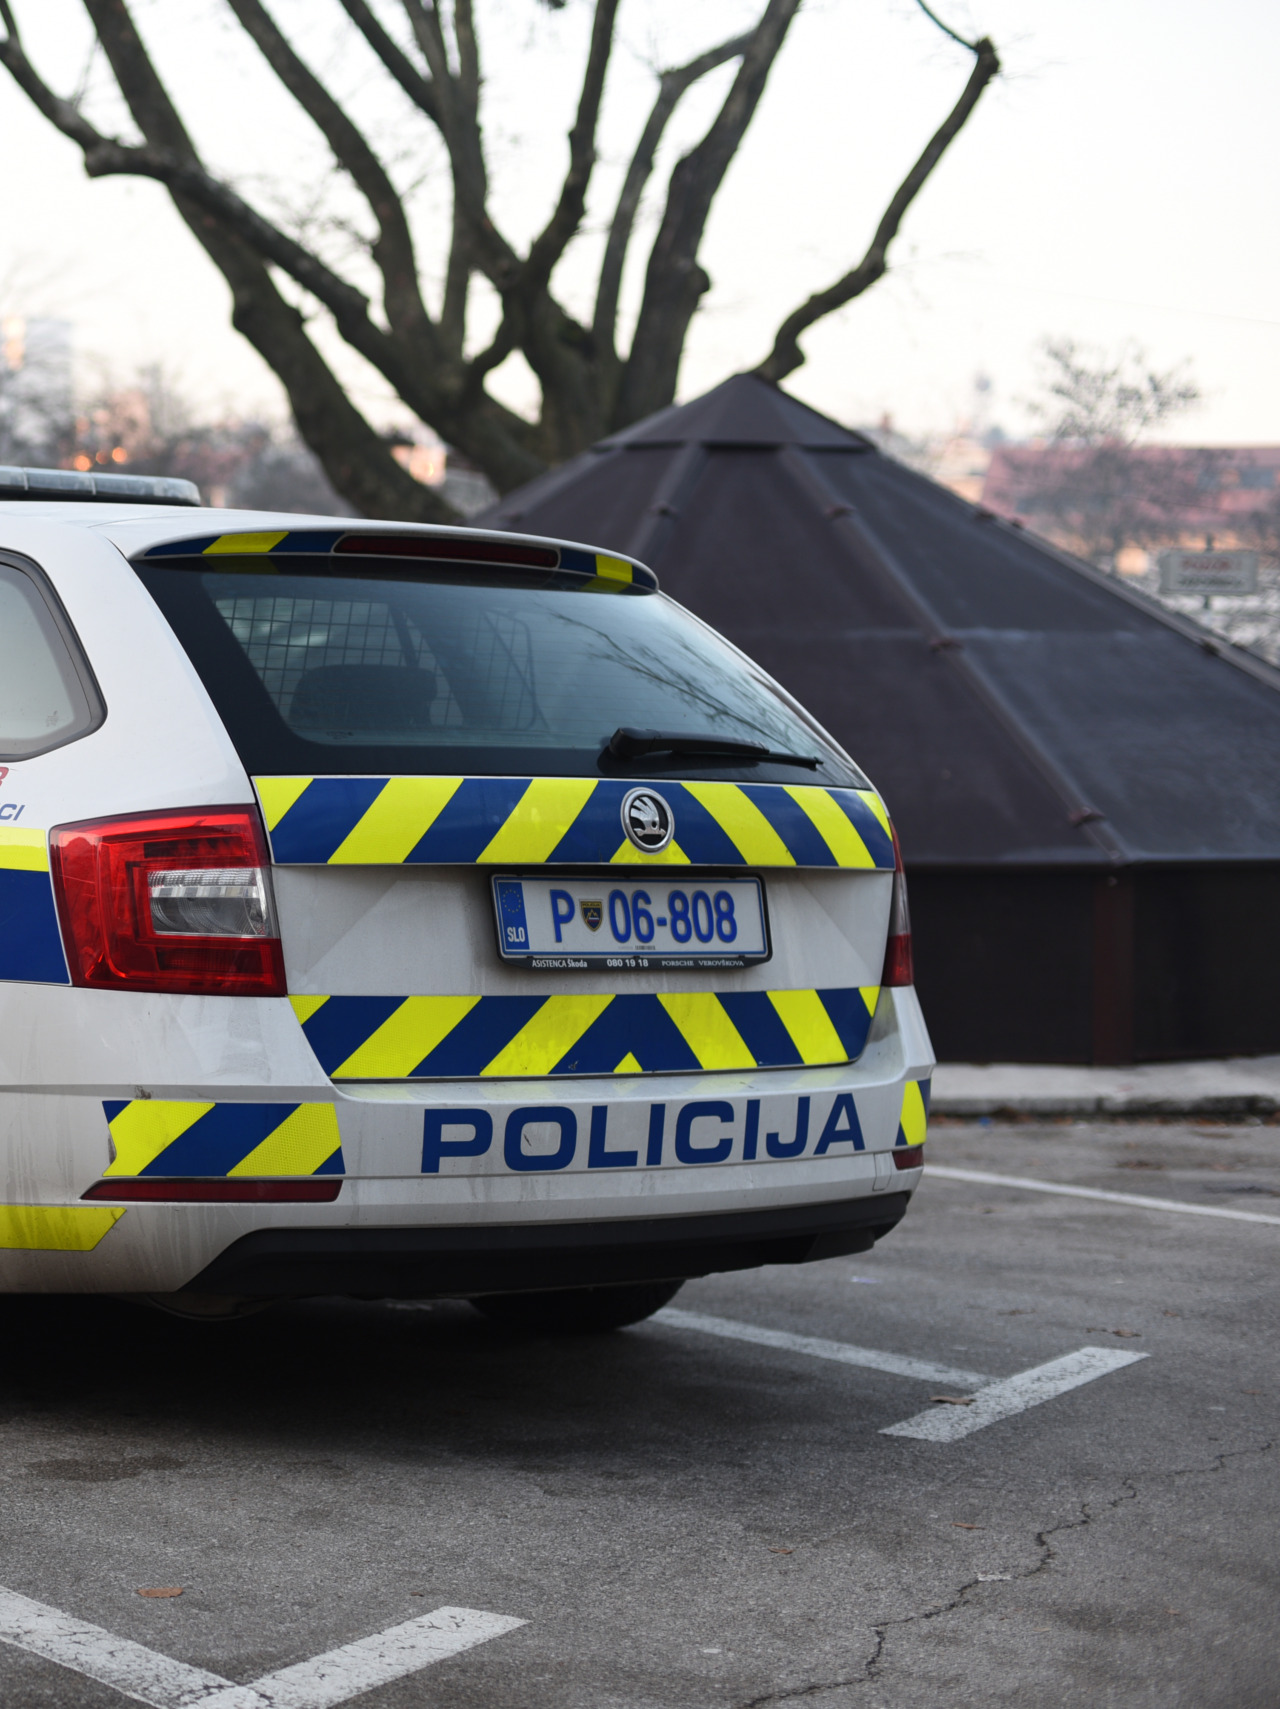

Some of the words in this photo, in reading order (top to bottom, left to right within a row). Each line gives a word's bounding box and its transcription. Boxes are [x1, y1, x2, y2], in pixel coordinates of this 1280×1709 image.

[507, 926, 526, 943] SLO
[549, 889, 575, 943] P
[608, 889, 738, 944] 06-808
[531, 959, 568, 968] ASISTENCA
[567, 958, 588, 968] Škoda
[606, 959, 623, 967] 080
[625, 959, 636, 967] 19
[638, 959, 649, 967] 18
[420, 1092, 866, 1174] POLICIJA
